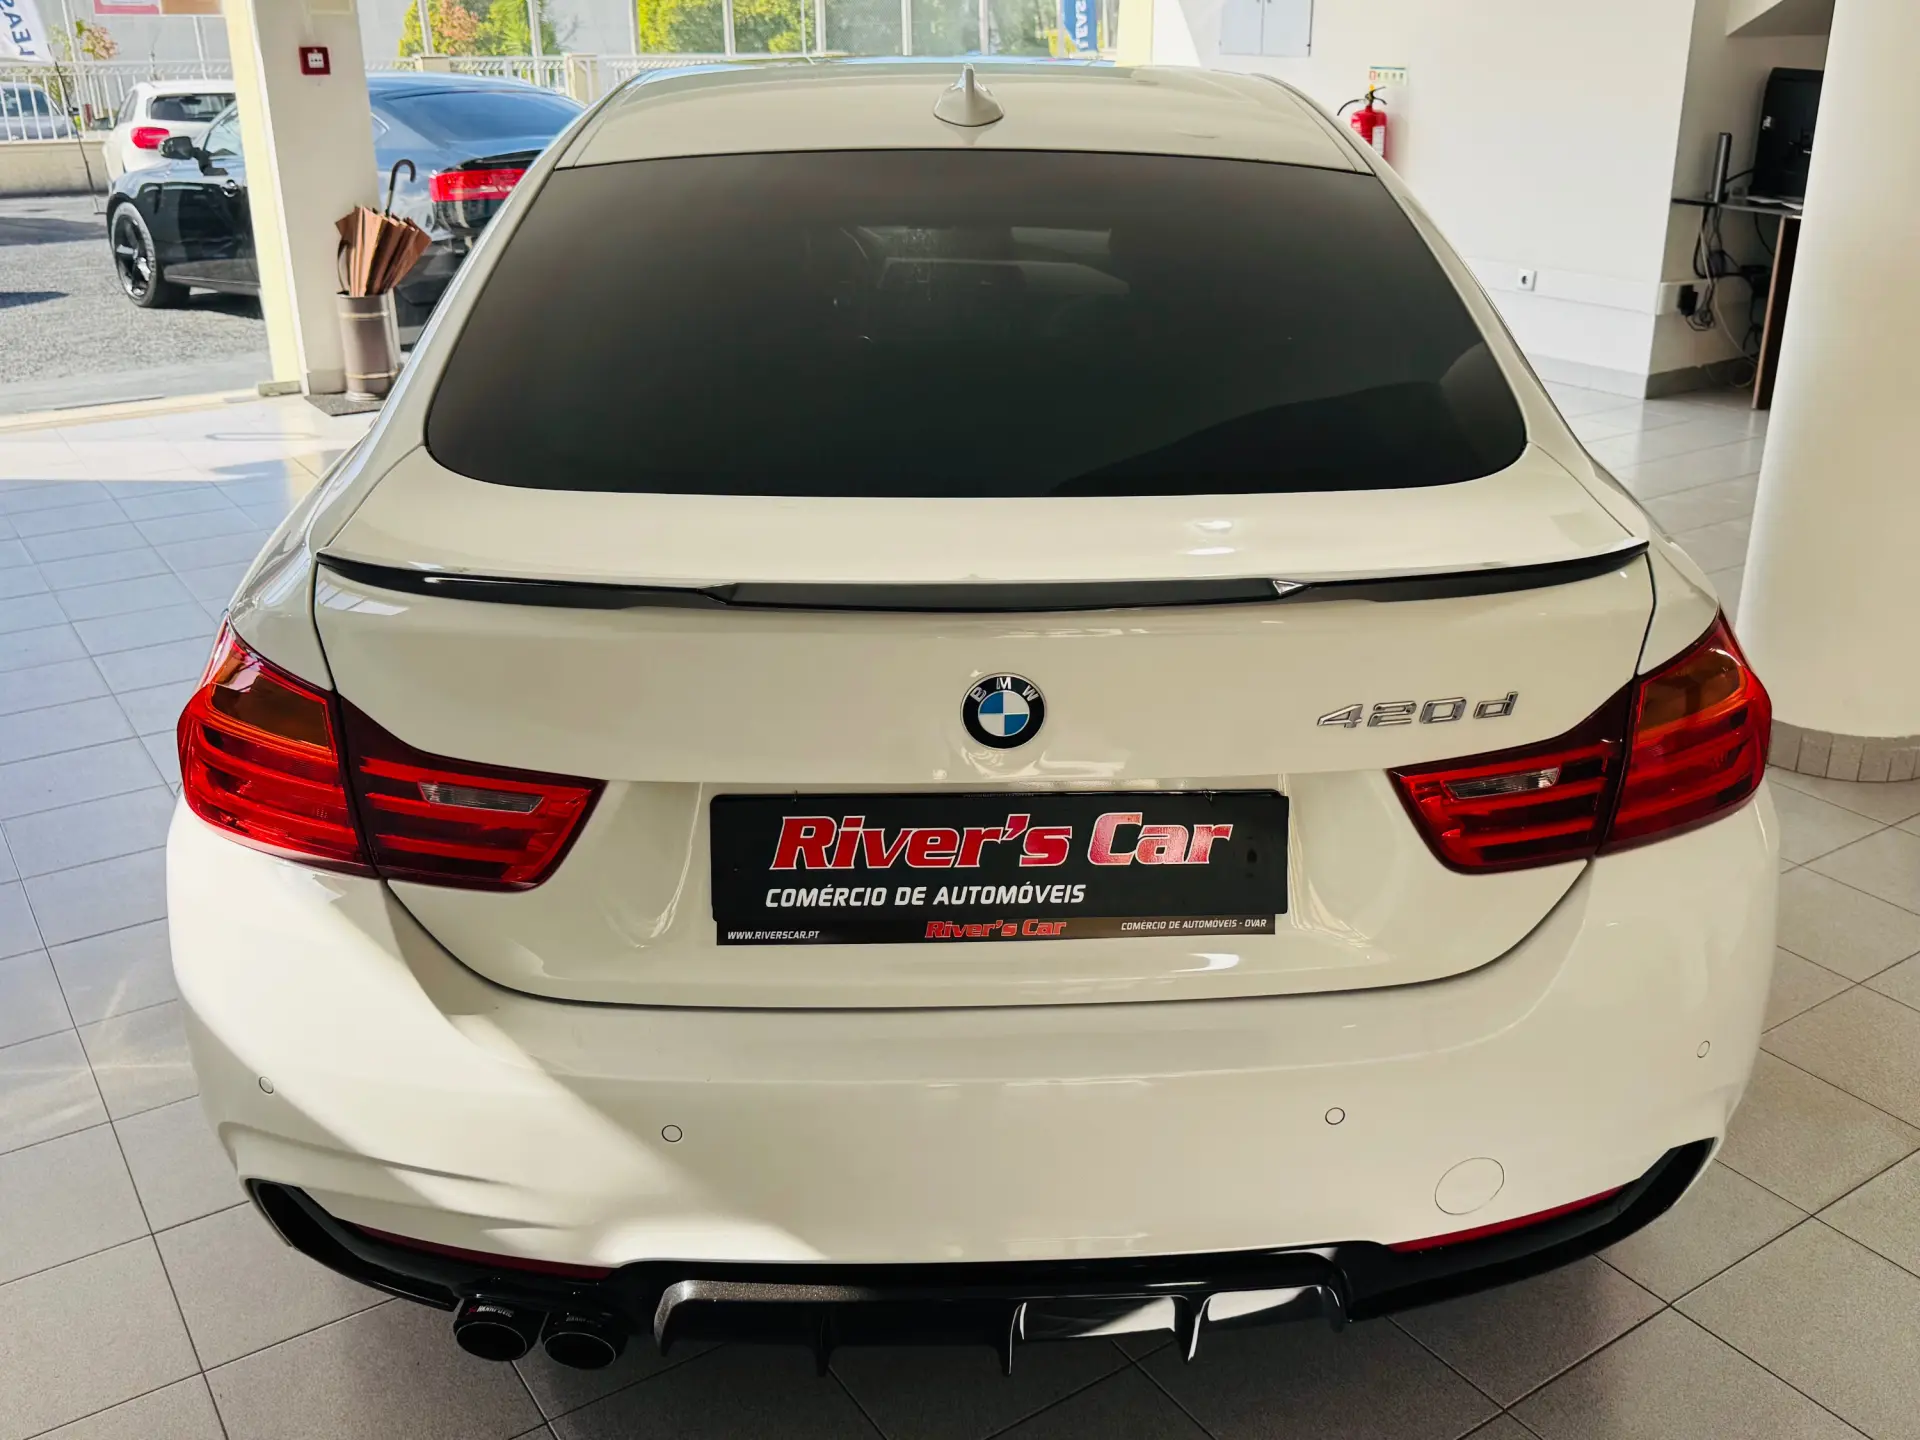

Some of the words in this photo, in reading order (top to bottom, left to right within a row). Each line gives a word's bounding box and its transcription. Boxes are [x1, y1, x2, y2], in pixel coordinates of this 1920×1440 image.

[970, 676, 1040, 703] BMW
[769, 814, 1073, 870] River's
[1087, 812, 1234, 866] Car
[765, 884, 887, 908] COMÉRCIO
[894, 886, 927, 906] DE
[932, 881, 1087, 906] AUTOMÓVEIS
[727, 930, 820, 940] WWW.RIVERSCAR.PT
[925, 920, 1018, 938] River's
[1021, 918, 1067, 936] Car
[1121, 920, 1167, 931] COMÉRCIO
[1168, 920, 1181, 929] DE
[1182, 917, 1237, 929] AUTOMÓVEIS
[1244, 918, 1267, 928] OVAR
